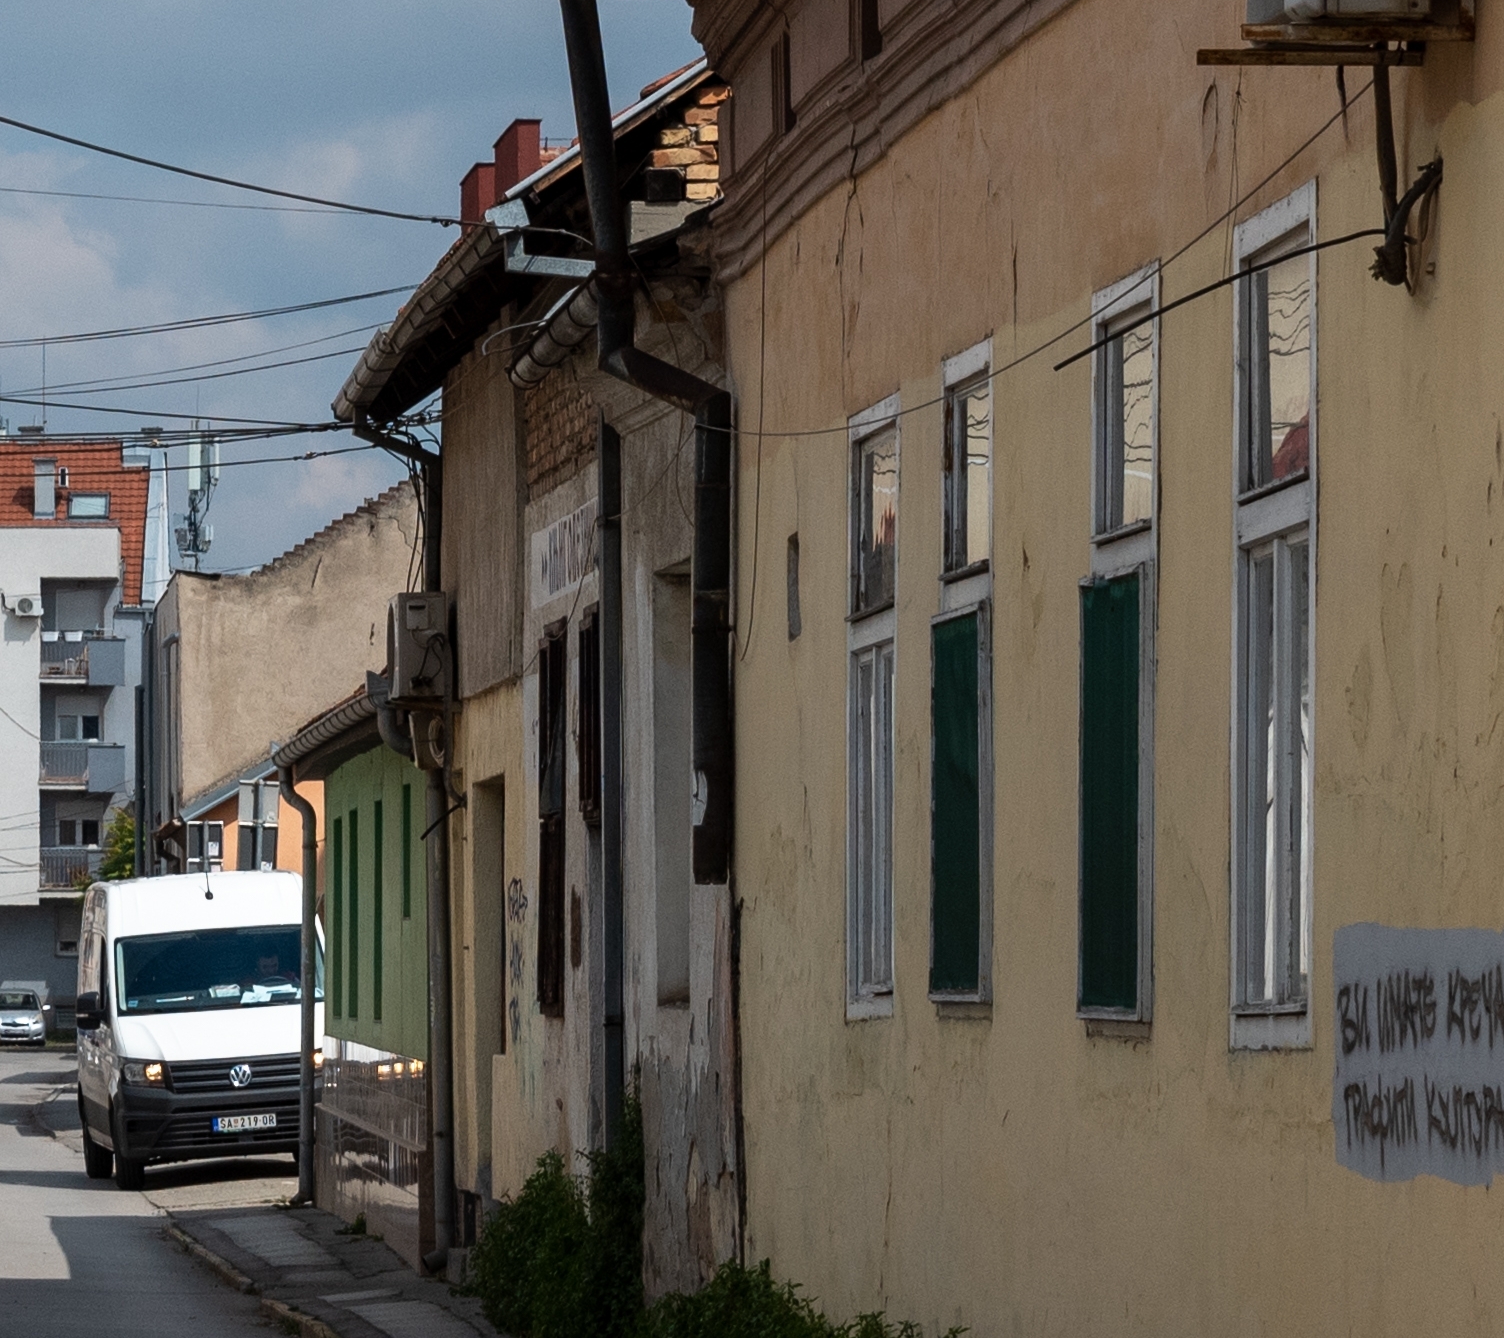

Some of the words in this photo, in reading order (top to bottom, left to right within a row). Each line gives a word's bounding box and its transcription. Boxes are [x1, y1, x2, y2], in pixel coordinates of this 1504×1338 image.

[1337, 981, 1370, 1056] ВИ
[1377, 969, 1436, 1053] ИМАТЕ
[220, 1118, 233, 1129] SA
